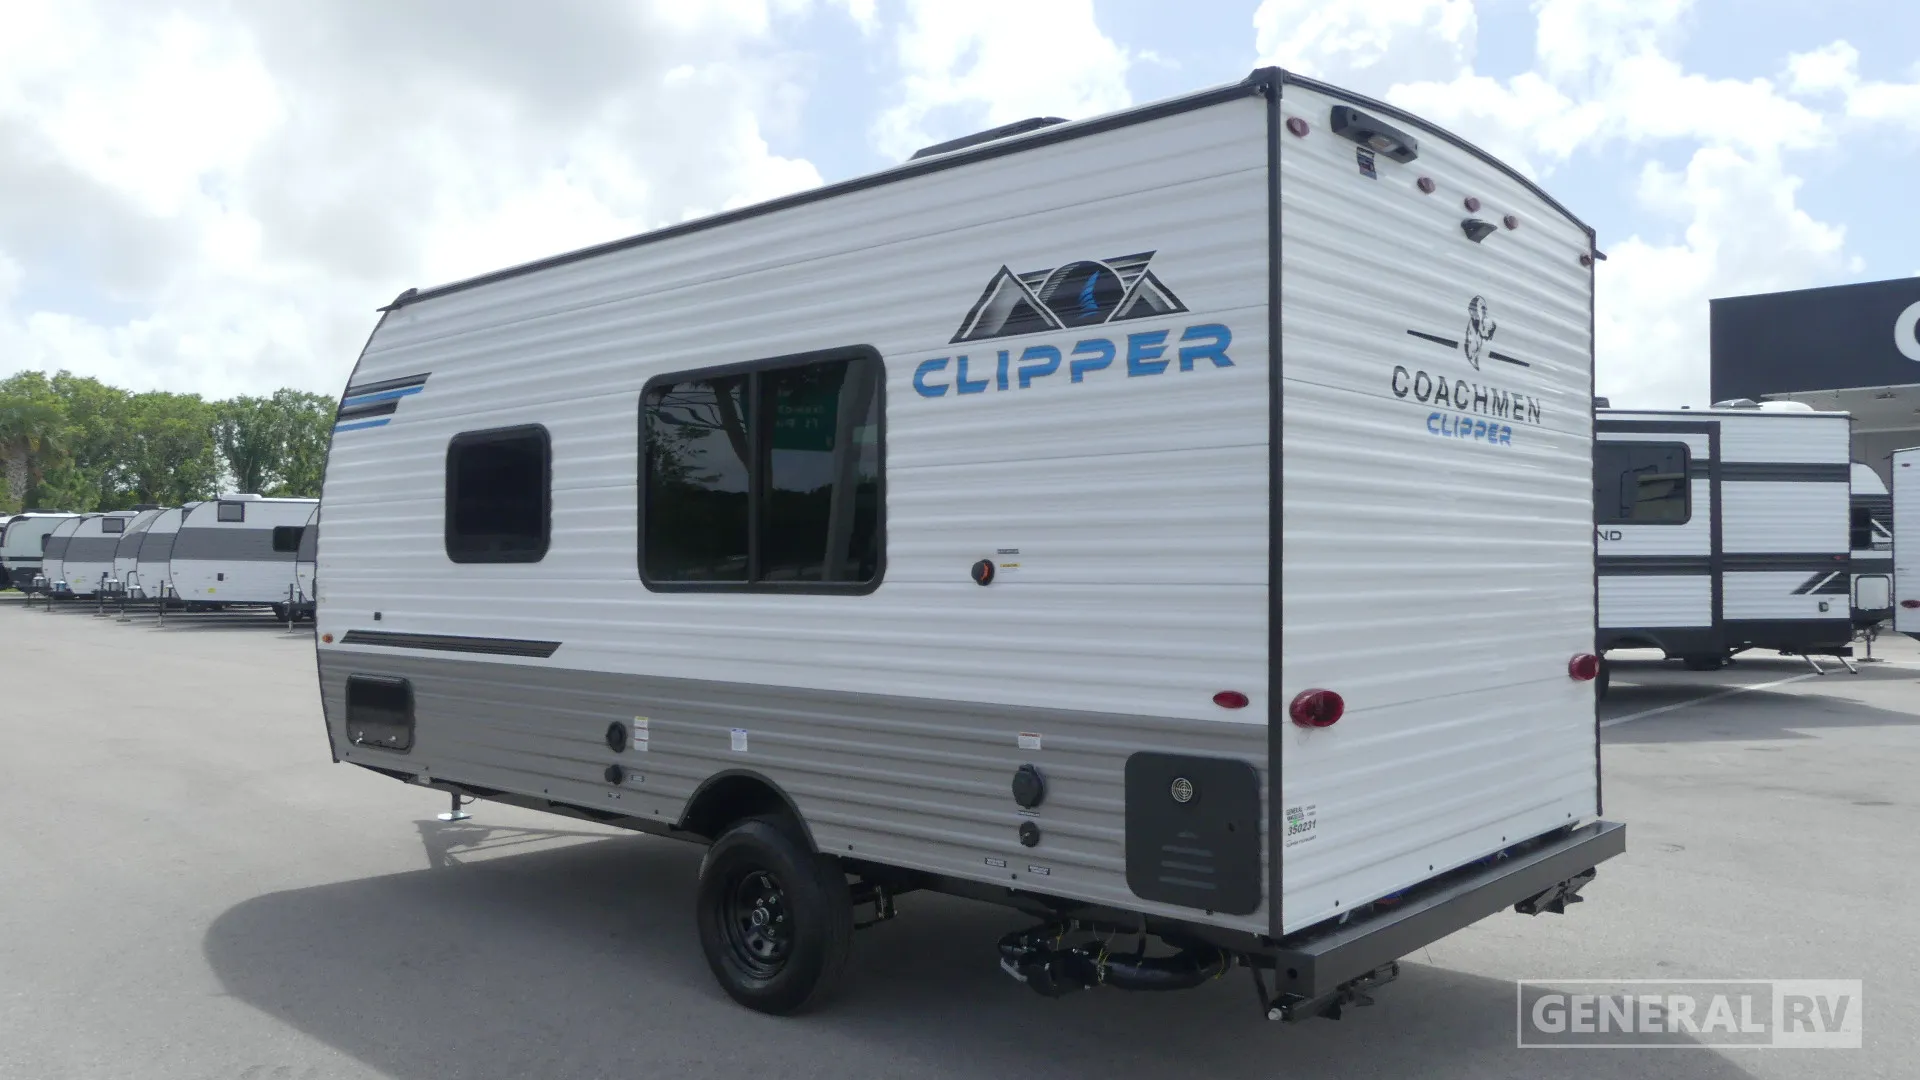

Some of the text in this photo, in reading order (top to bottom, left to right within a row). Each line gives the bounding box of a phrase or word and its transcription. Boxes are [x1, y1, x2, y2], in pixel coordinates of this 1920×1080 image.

[912, 323, 1236, 398] CLIPPER
[1391, 365, 1541, 425] COACHMEN
[1426, 411, 1513, 447] CLIPPER
